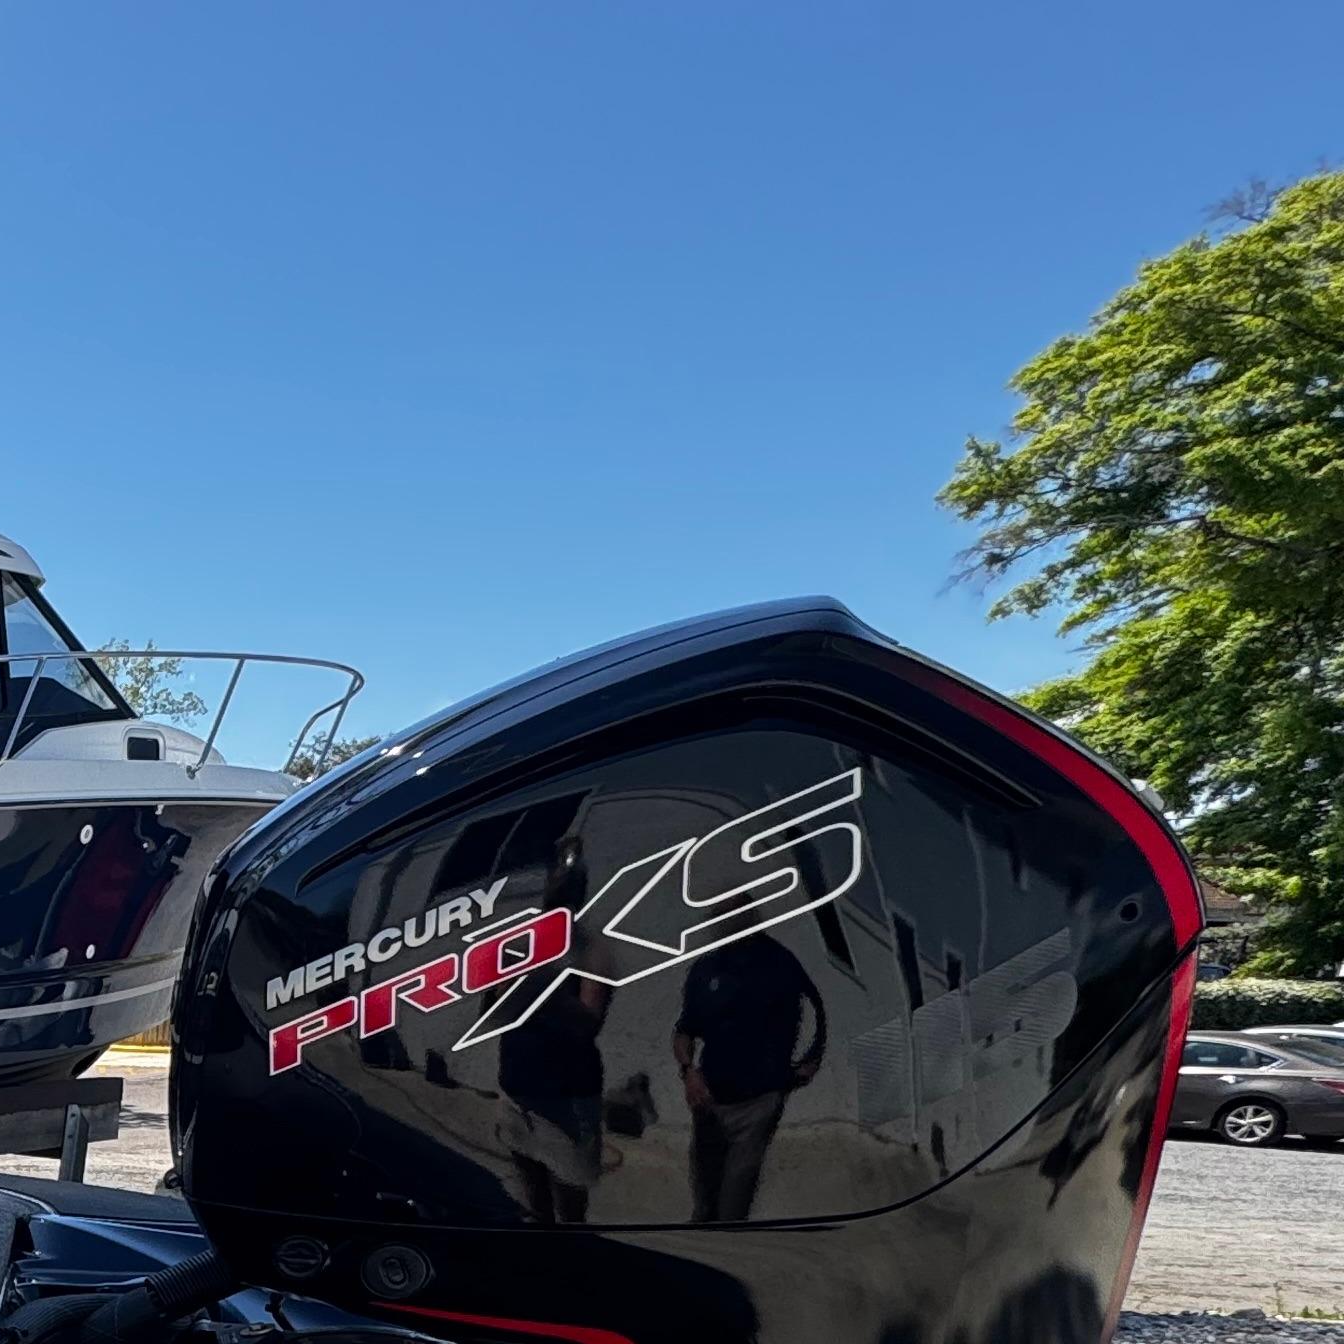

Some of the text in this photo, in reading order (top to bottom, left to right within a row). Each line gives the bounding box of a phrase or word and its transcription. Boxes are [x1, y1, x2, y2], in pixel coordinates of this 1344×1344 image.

[265, 878, 508, 1011] MERCURY
[269, 767, 862, 1077] PRO XS
